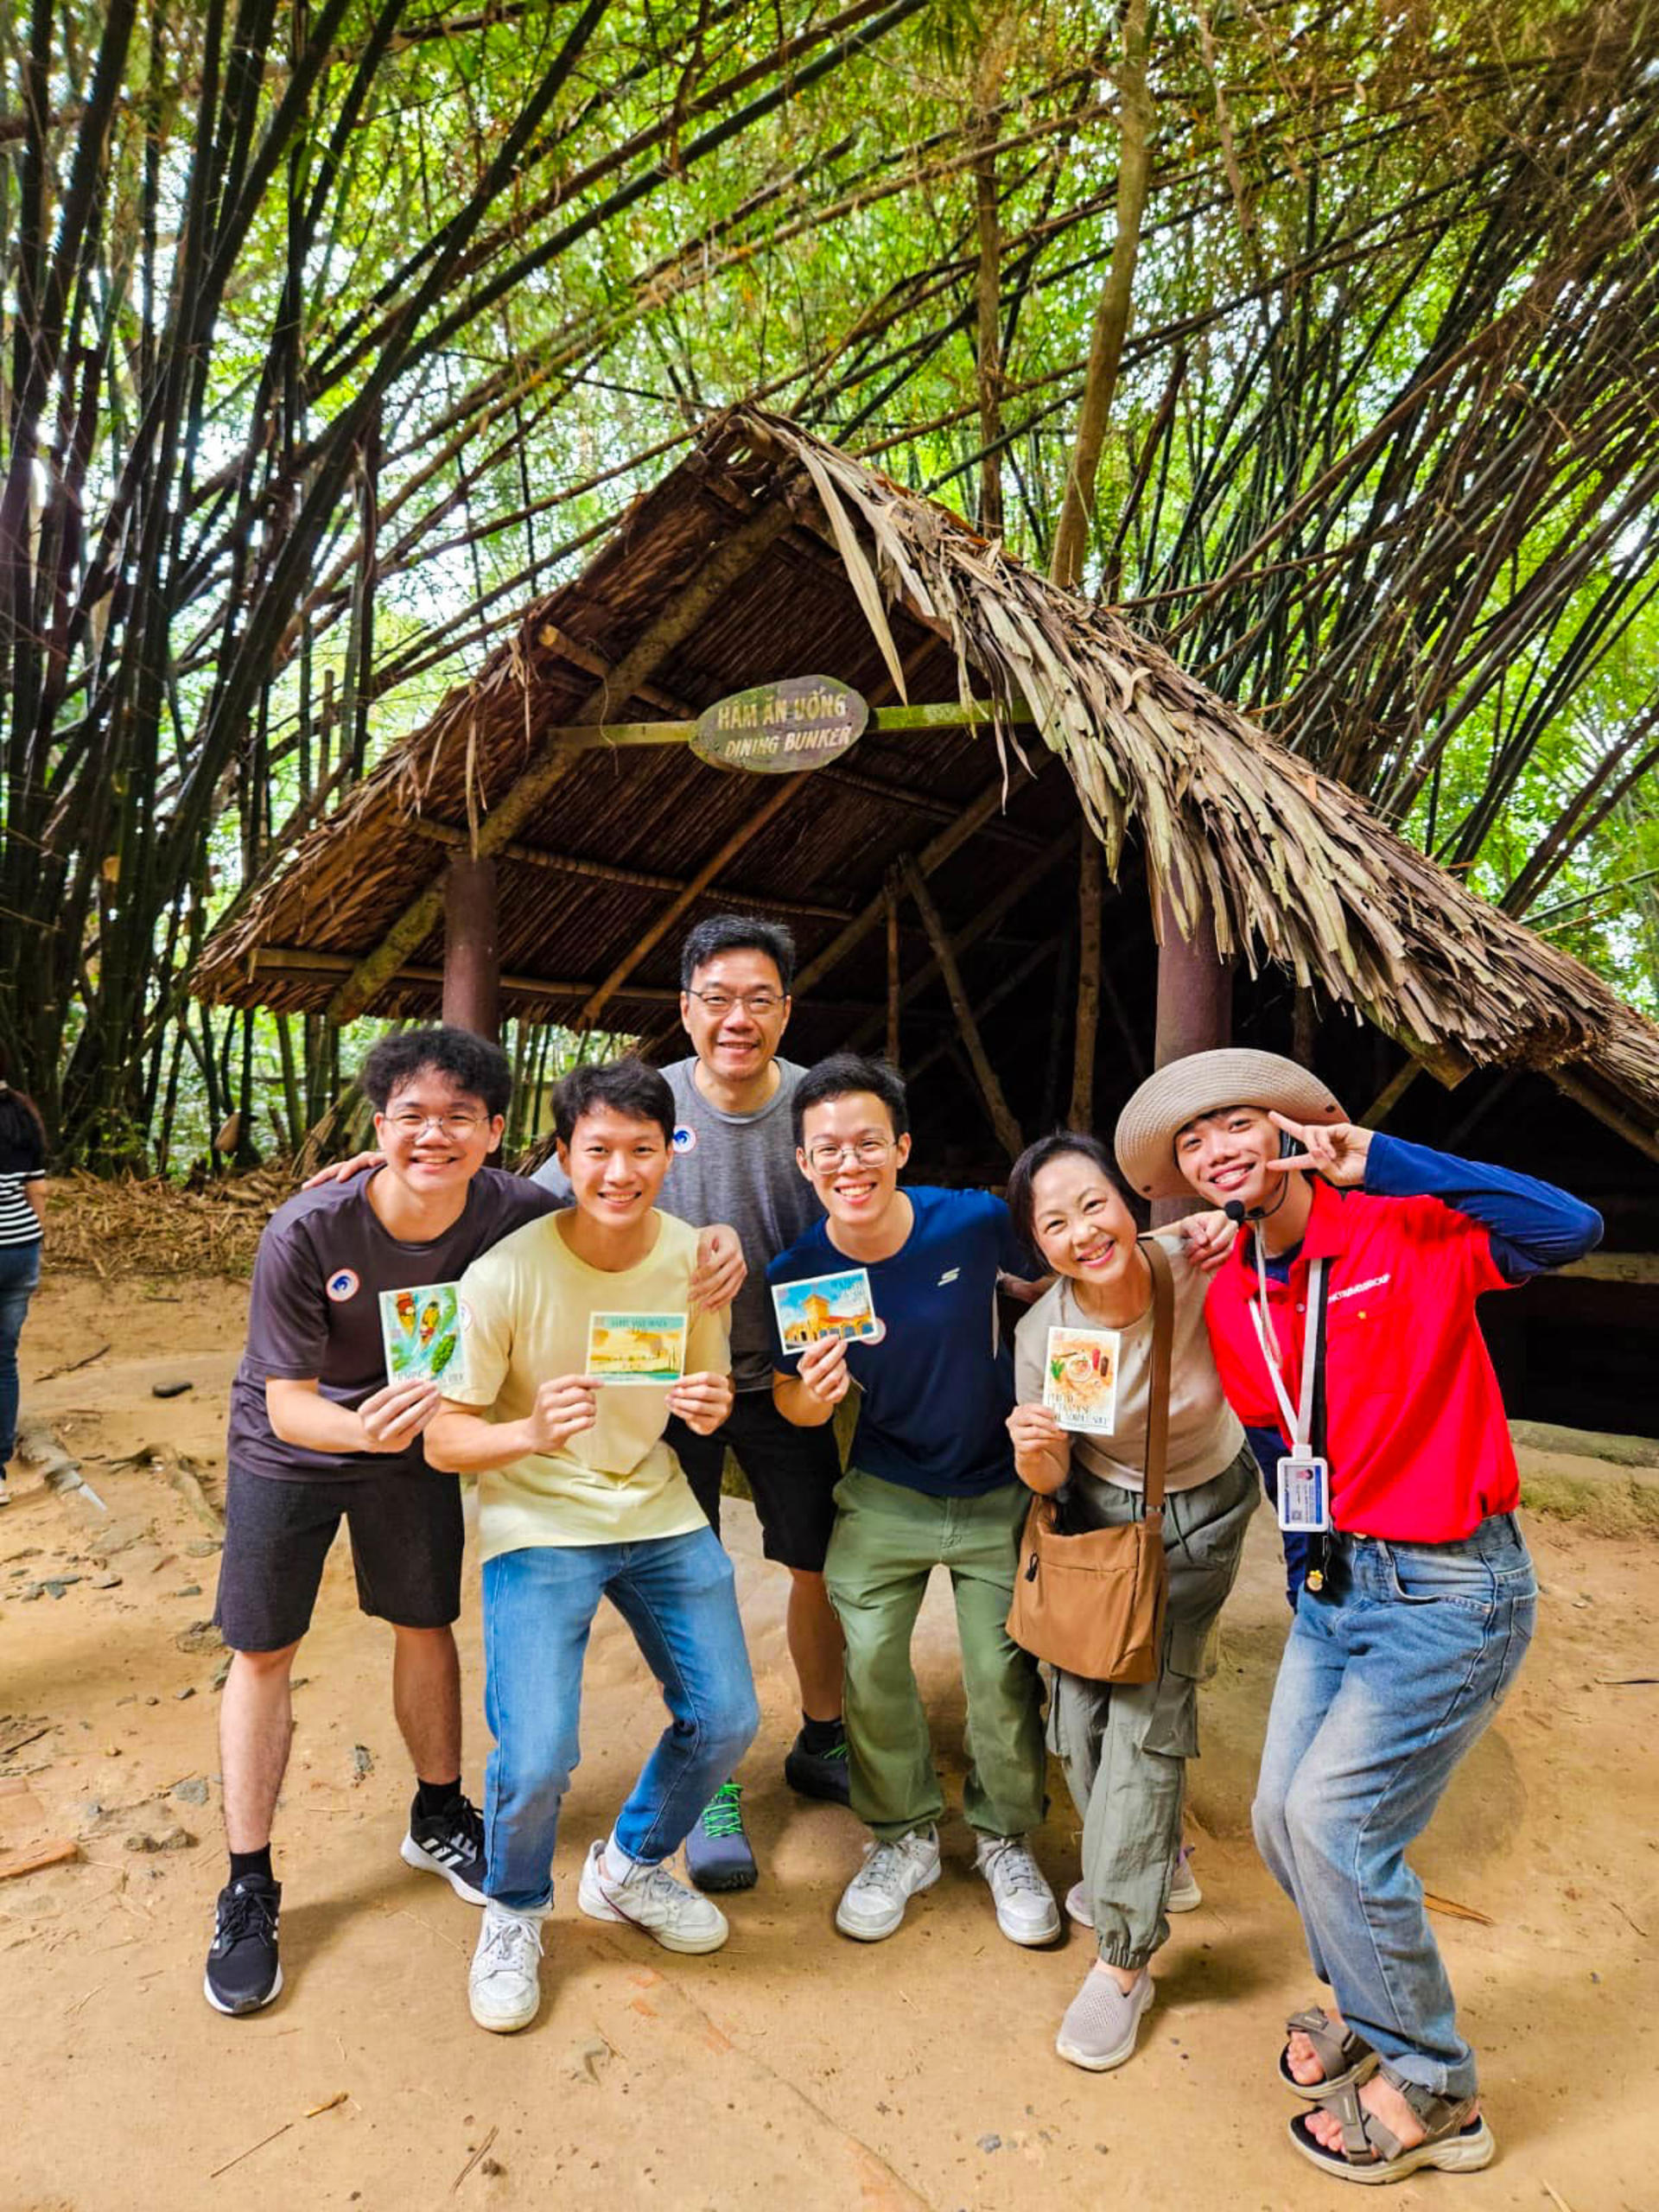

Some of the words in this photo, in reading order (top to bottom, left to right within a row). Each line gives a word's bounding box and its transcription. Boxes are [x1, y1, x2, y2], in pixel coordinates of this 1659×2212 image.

[762, 696, 786, 725] ĂN
[725, 735, 779, 758] DINING
[784, 727, 851, 751] BUNKER
